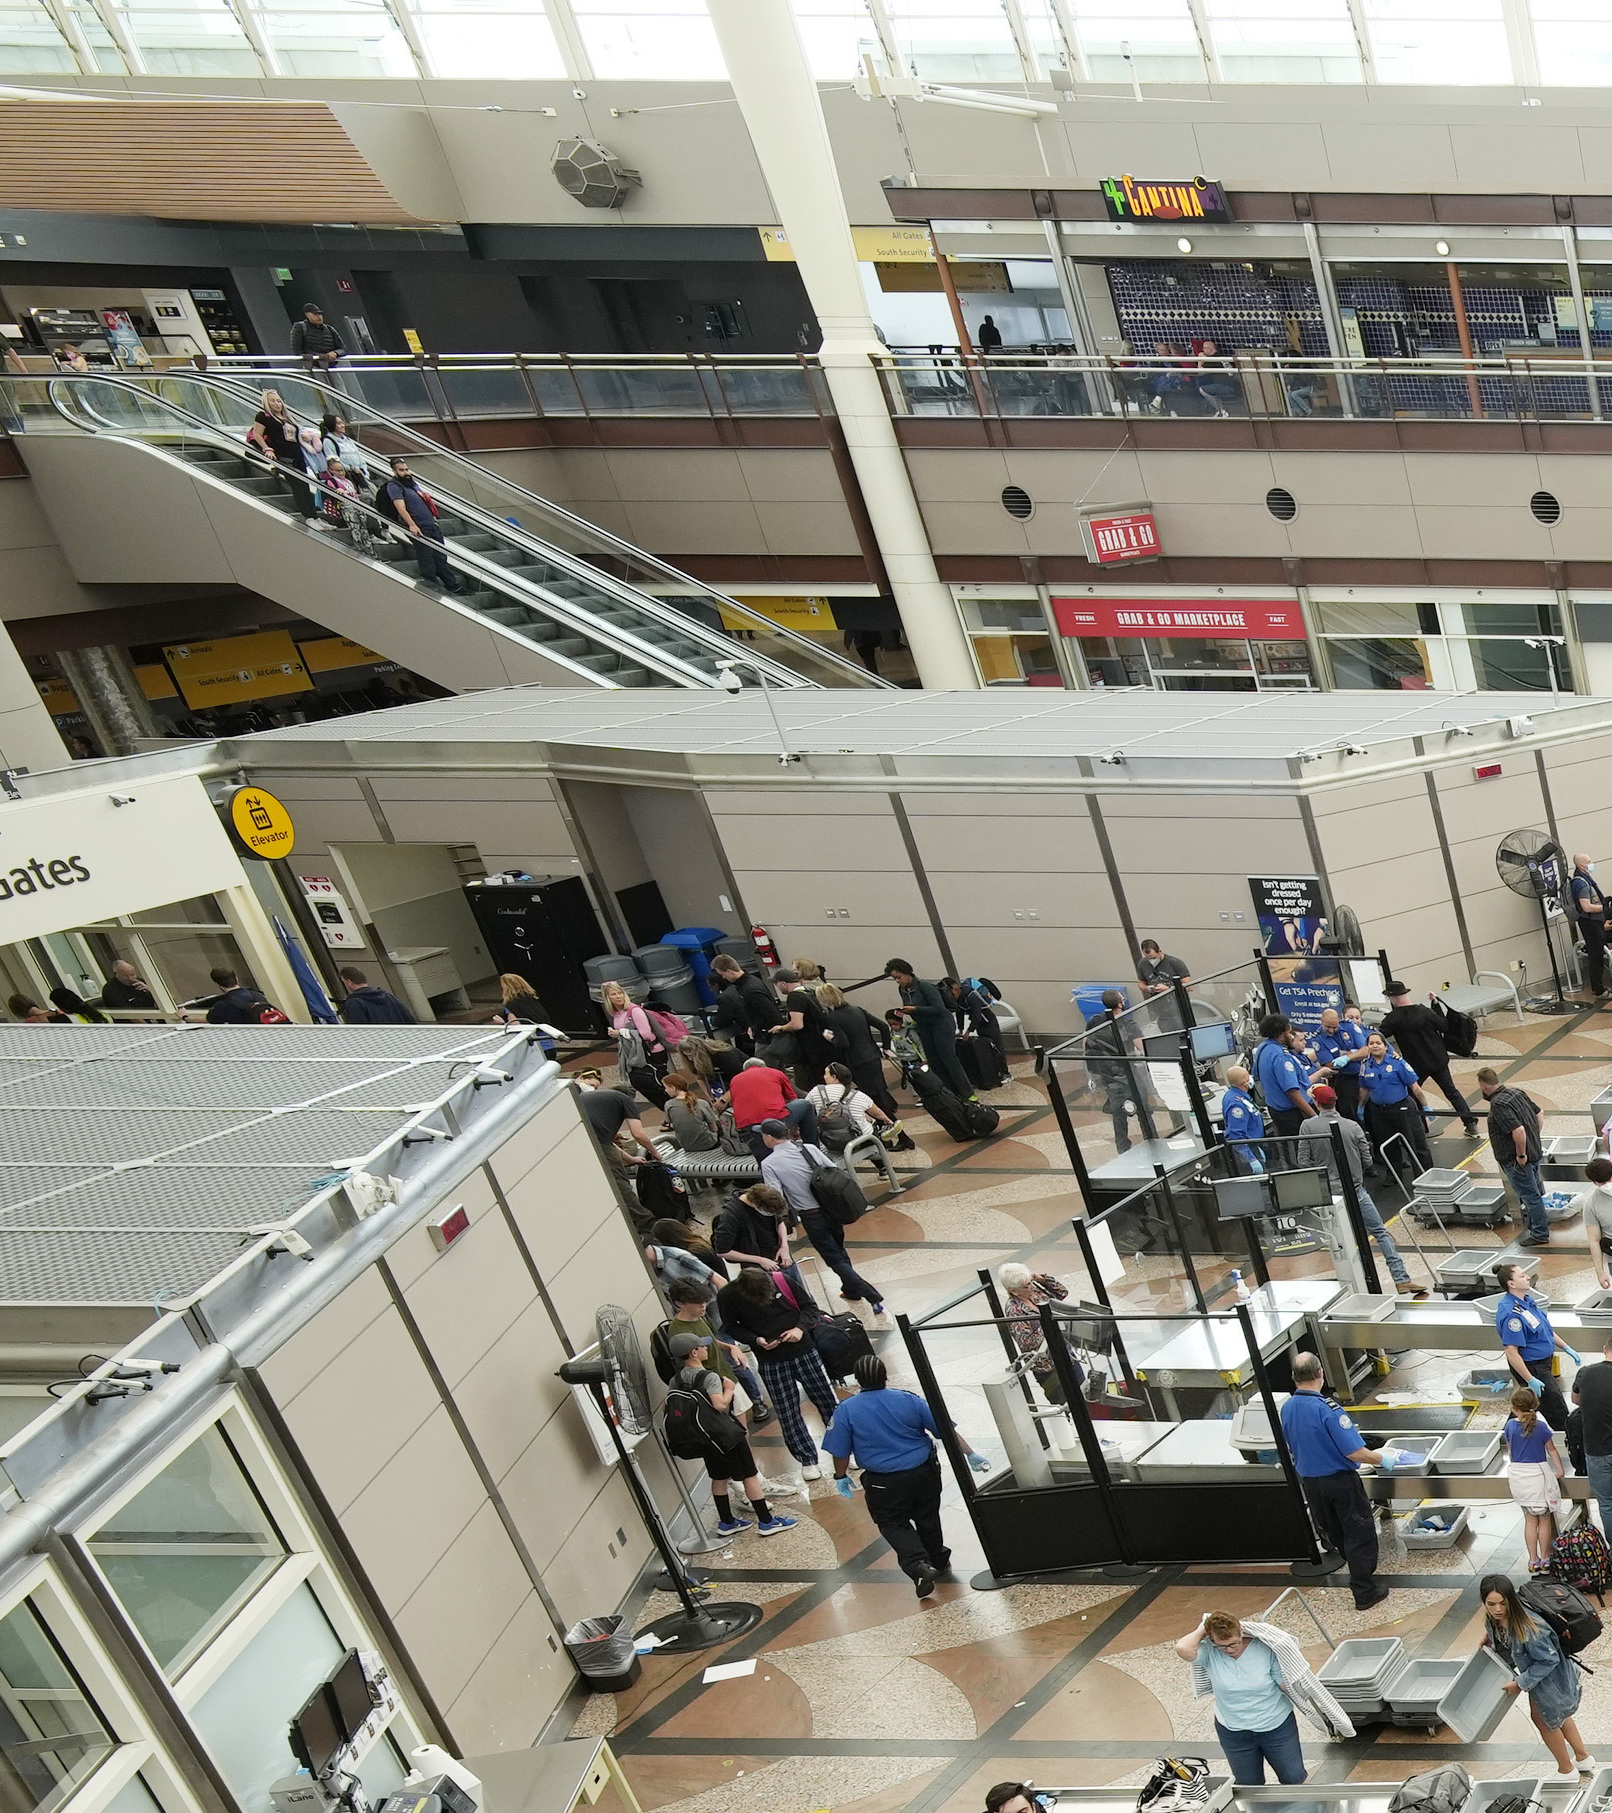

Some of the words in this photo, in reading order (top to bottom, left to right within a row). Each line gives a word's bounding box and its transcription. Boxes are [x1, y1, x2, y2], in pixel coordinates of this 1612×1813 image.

[1122, 174, 1205, 217] CANTINA
[892, 231, 902, 240] All
[903, 231, 923, 240] Gates
[876, 248, 897, 256] South
[898, 248, 927, 258] Security
[1098, 529, 1127, 551] GRAB
[1128, 527, 1138, 547] &
[1139, 524, 1154, 545] GO
[1117, 612, 1144, 625] GRAB
[1147, 613, 1155, 625] &
[1157, 613, 1171, 625] GO
[1174, 613, 1245, 626] MARKETPLACE
[250, 830, 289, 847] Elevator
[1262, 880, 1280, 890] Isn't
[1279, 881, 1307, 892] getting
[1271, 889, 1301, 898] dressed
[1264, 898, 1283, 906] once
[1283, 899, 1297, 908] per
[1297, 898, 1312, 908] day
[1274, 906, 1306, 916] enough?
[1279, 987, 1292, 997] Get
[1292, 987, 1307, 997] TSA
[1278, 1216, 1296, 1228] 10
[286, 1793, 315, 1803] iLane
